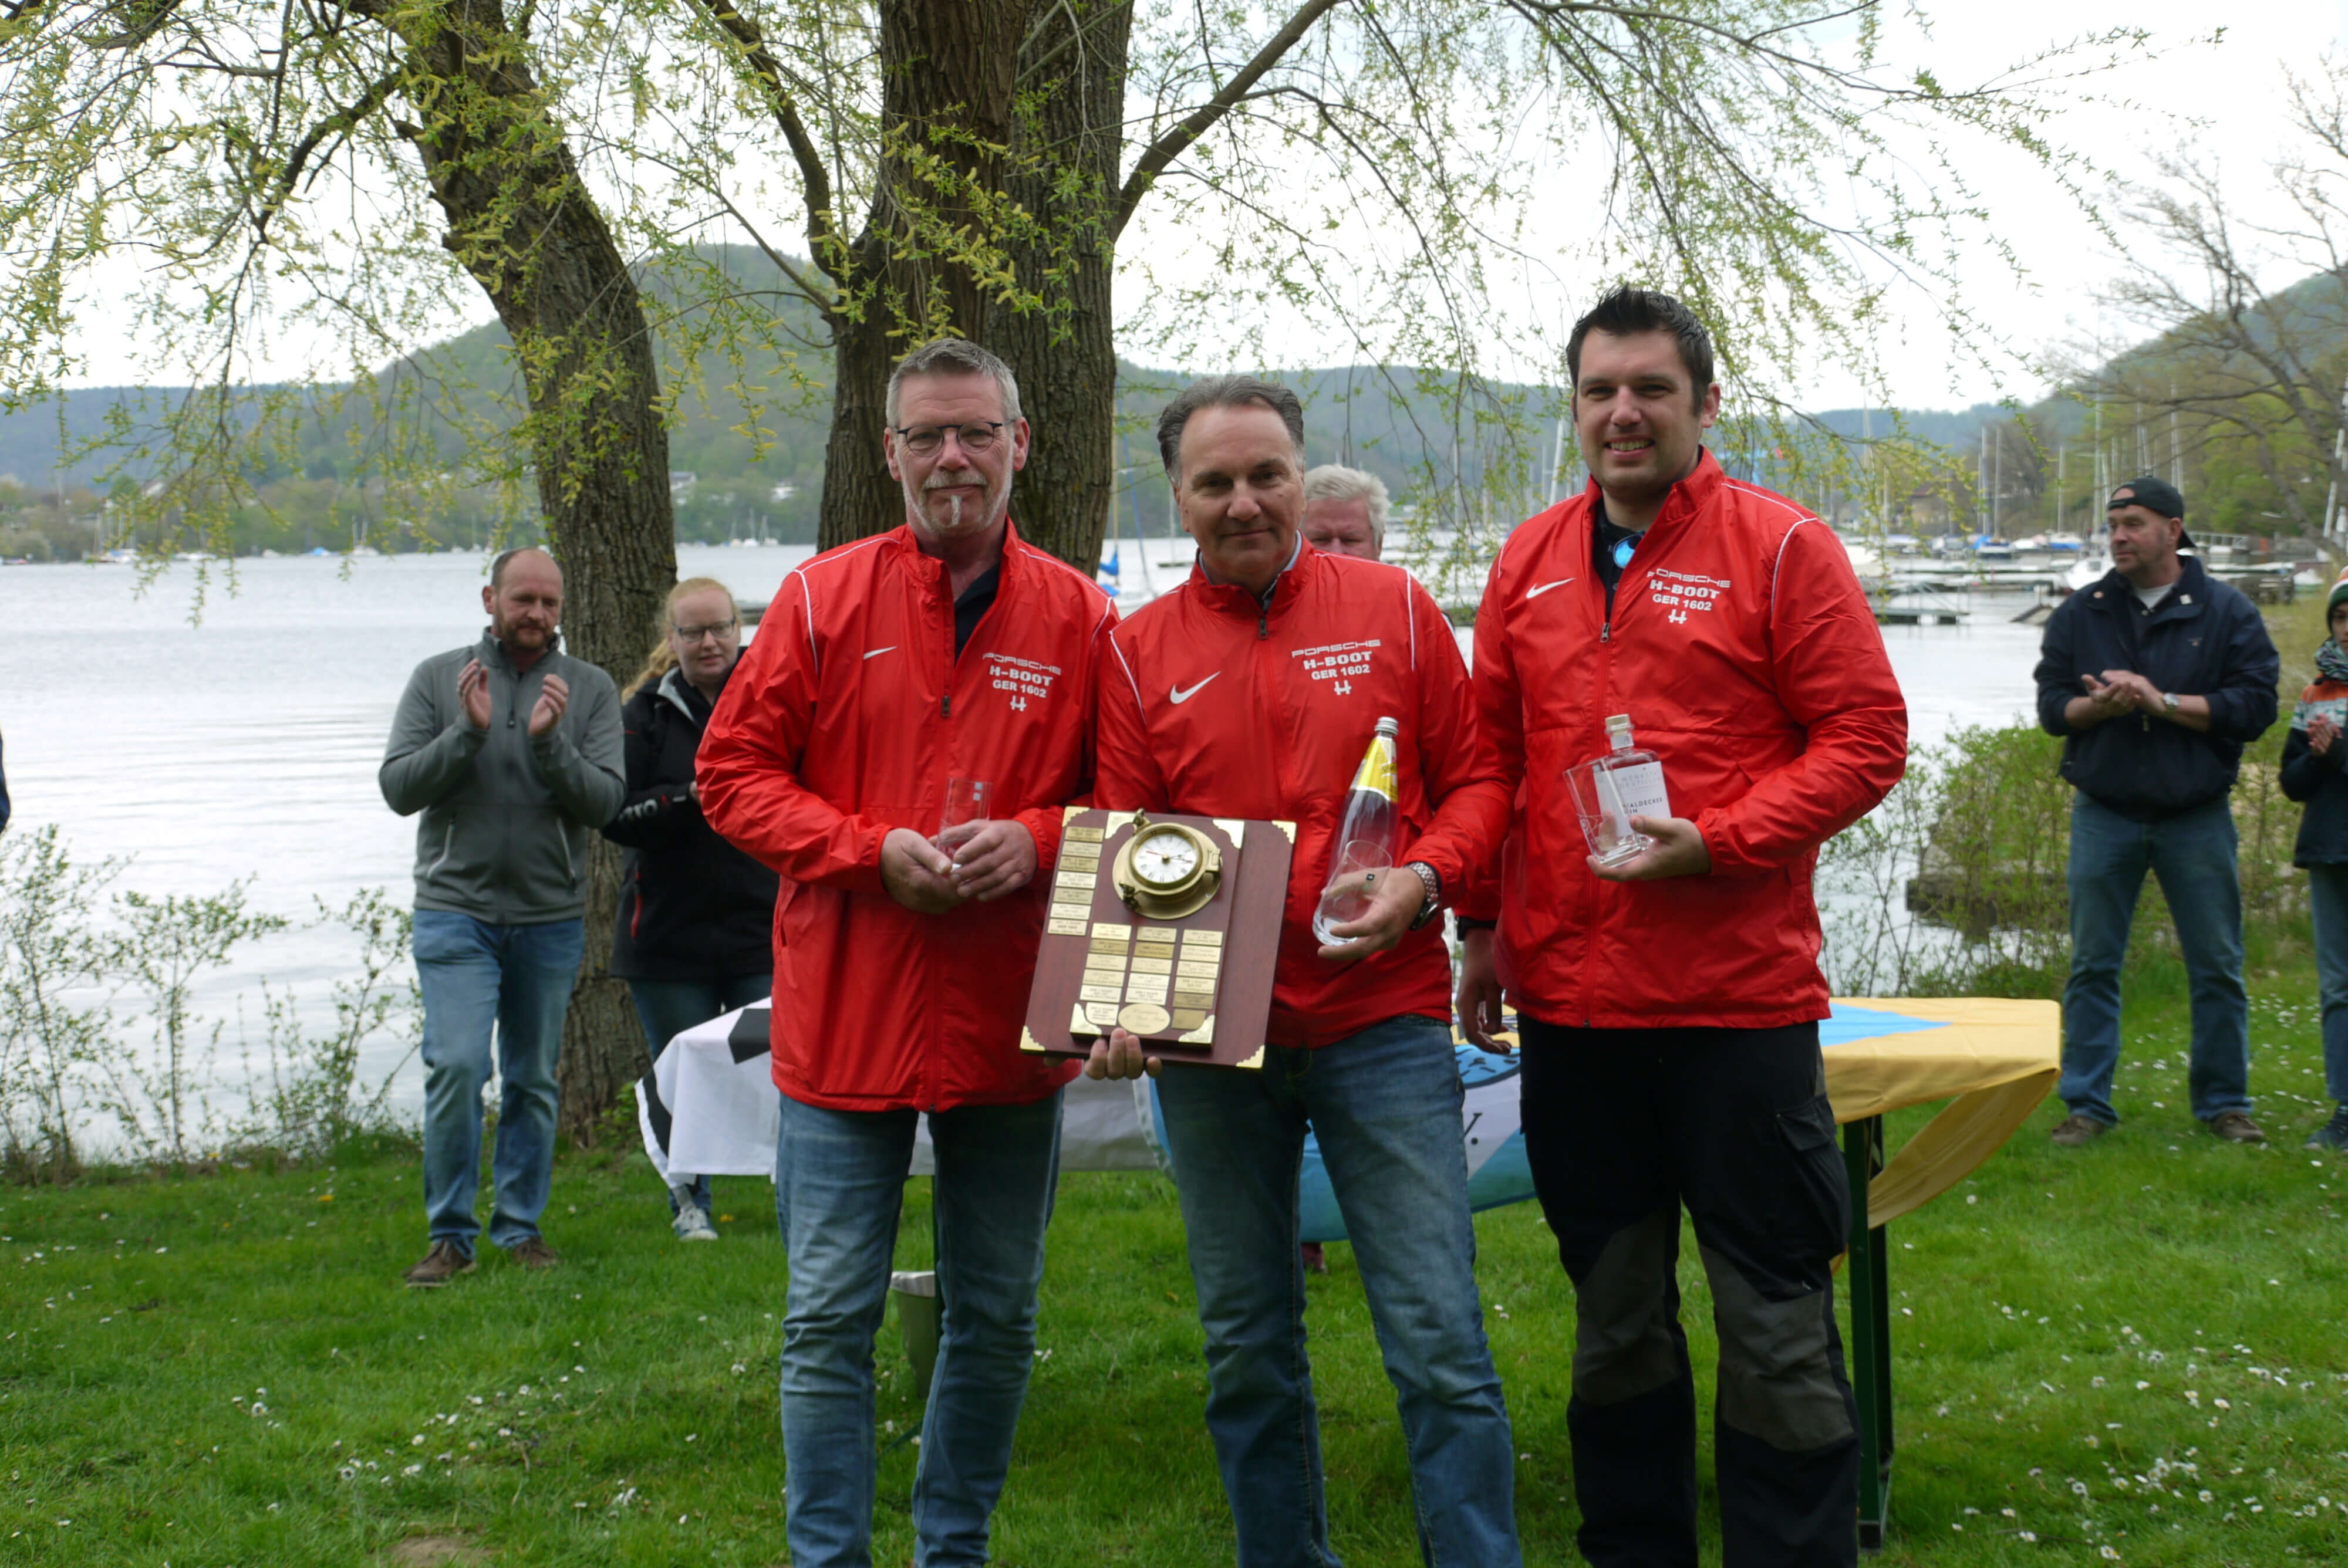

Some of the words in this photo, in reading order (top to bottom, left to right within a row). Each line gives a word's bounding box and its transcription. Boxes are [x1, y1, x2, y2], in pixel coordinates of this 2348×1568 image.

[1649, 579, 1720, 599] H-BOOT
[1652, 593, 1679, 606] GER
[1682, 599, 1712, 611] 1602
[1291, 639, 1381, 658] PORSCHE
[982, 652, 1061, 675] PORSCHE
[1303, 651, 1372, 670] H-BOOT
[989, 665, 1053, 686] H-BOOT
[1311, 669, 1338, 680] GER
[1340, 664, 1371, 676] 1602
[992, 679, 1017, 691] GER
[1020, 684, 1047, 698] 1602
